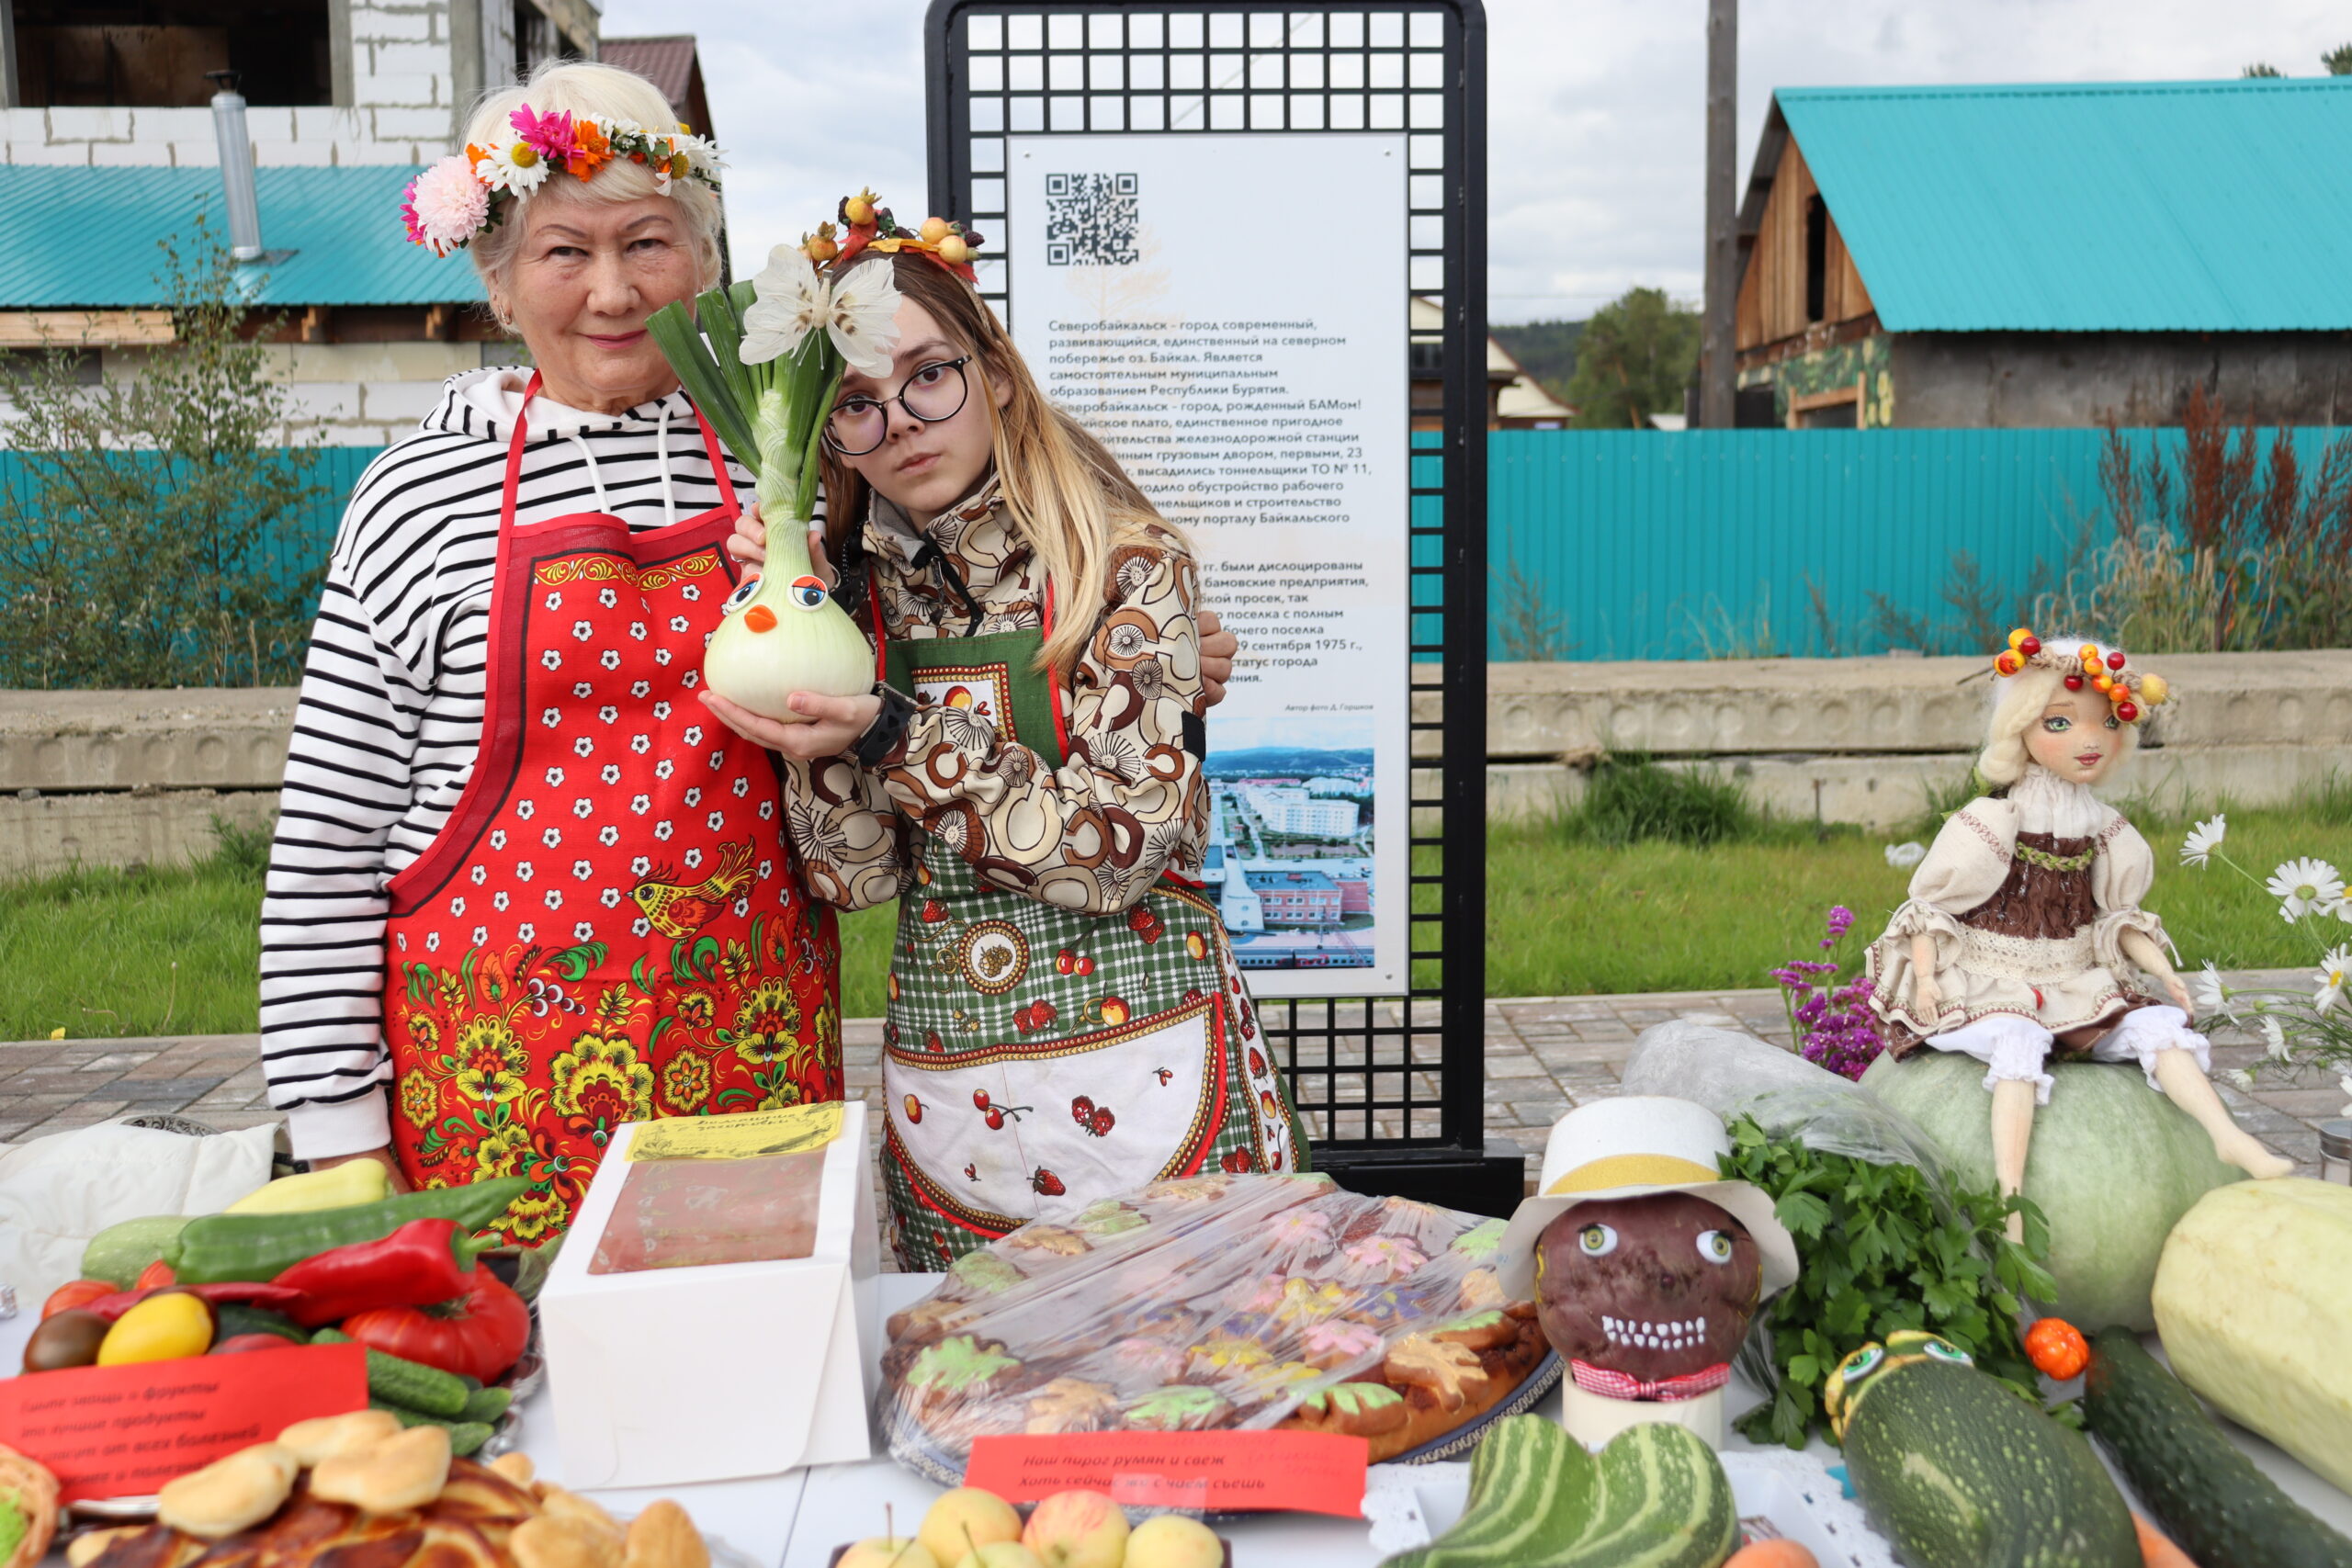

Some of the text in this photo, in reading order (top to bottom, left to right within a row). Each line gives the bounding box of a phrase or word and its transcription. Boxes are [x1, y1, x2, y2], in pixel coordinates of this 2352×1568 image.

[1047, 319, 1168, 333] Северобайкальск
[1179, 321, 1220, 333] город
[1222, 317, 1317, 332] современный,
[1048, 333, 1347, 350] развивающийся, единственный на северном
[1048, 350, 1263, 366] побережье оз. Байкал. Является
[1048, 369, 1279, 381] самостоятельным муниципальным
[1049, 382, 1289, 398] образованием Республики Бурятия.
[1052, 400, 1169, 414] веробайкальск
[1180, 401, 1224, 413] город,
[1226, 398, 1306, 413] рожденный
[1308, 398, 1362, 410] БАМом!
[1074, 416, 1343, 429] ыйское плато, единственное пригодное
[1099, 431, 1360, 446] оительства железнодорожной станции
[1156, 450, 1220, 462] грузовым
[1222, 450, 1277, 461] двором,
[1280, 449, 1344, 461] первыми,
[1346, 446, 1363, 457] 23
[1136, 467, 1216, 478] высадились
[1218, 466, 1308, 477] тоннельщики
[1310, 462, 1330, 475] ТО
[1352, 462, 1372, 476] 11,
[1187, 479, 1280, 493] обустройство
[1282, 478, 1344, 493] рабочего
[1234, 498, 1243, 507] и
[1245, 498, 1342, 510] строительство
[1203, 514, 1257, 526] порталу
[1259, 511, 1351, 523] Байкальского
[1220, 559, 1255, 571] были
[1257, 562, 1363, 573] дислоцированы
[1204, 575, 1369, 589] бамовские предприятия,
[1234, 593, 1285, 605] просек,
[1286, 593, 1309, 603] так
[1227, 610, 1280, 619] поселка
[1293, 609, 1344, 618] полным
[1220, 623, 1325, 635] бочего поселка
[1250, 638, 1312, 653] сентября
[1315, 637, 1347, 649] 1975
[1272, 657, 1318, 669] города
[1023, 1454, 1227, 1468] Наш пирог румян и свеж
[1018, 1475, 1061, 1486] Хоть
[1066, 1474, 1118, 1487] сейчас
[1213, 1477, 1266, 1489] съешь
